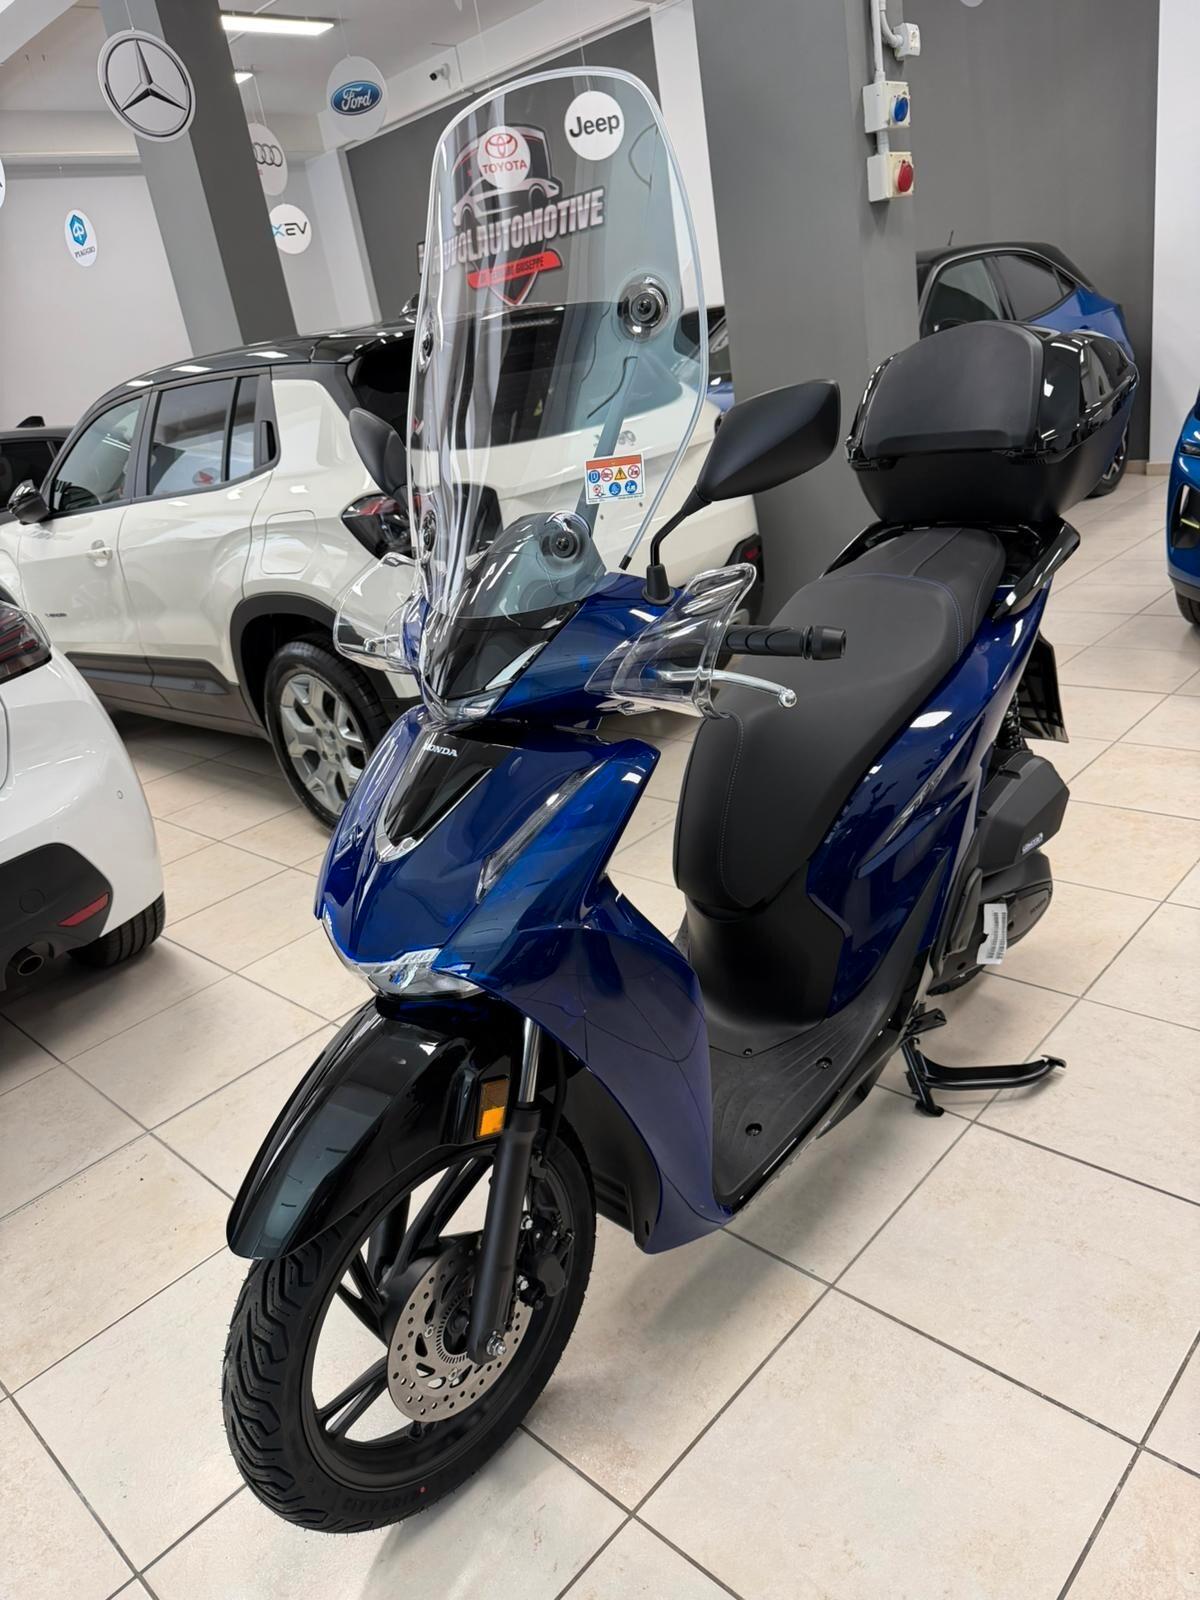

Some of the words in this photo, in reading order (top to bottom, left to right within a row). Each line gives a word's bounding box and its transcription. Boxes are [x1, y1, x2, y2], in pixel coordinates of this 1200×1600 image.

[341, 86, 372, 111] Ford
[569, 114, 620, 138] Jeep
[482, 160, 527, 174] TOYOTA
